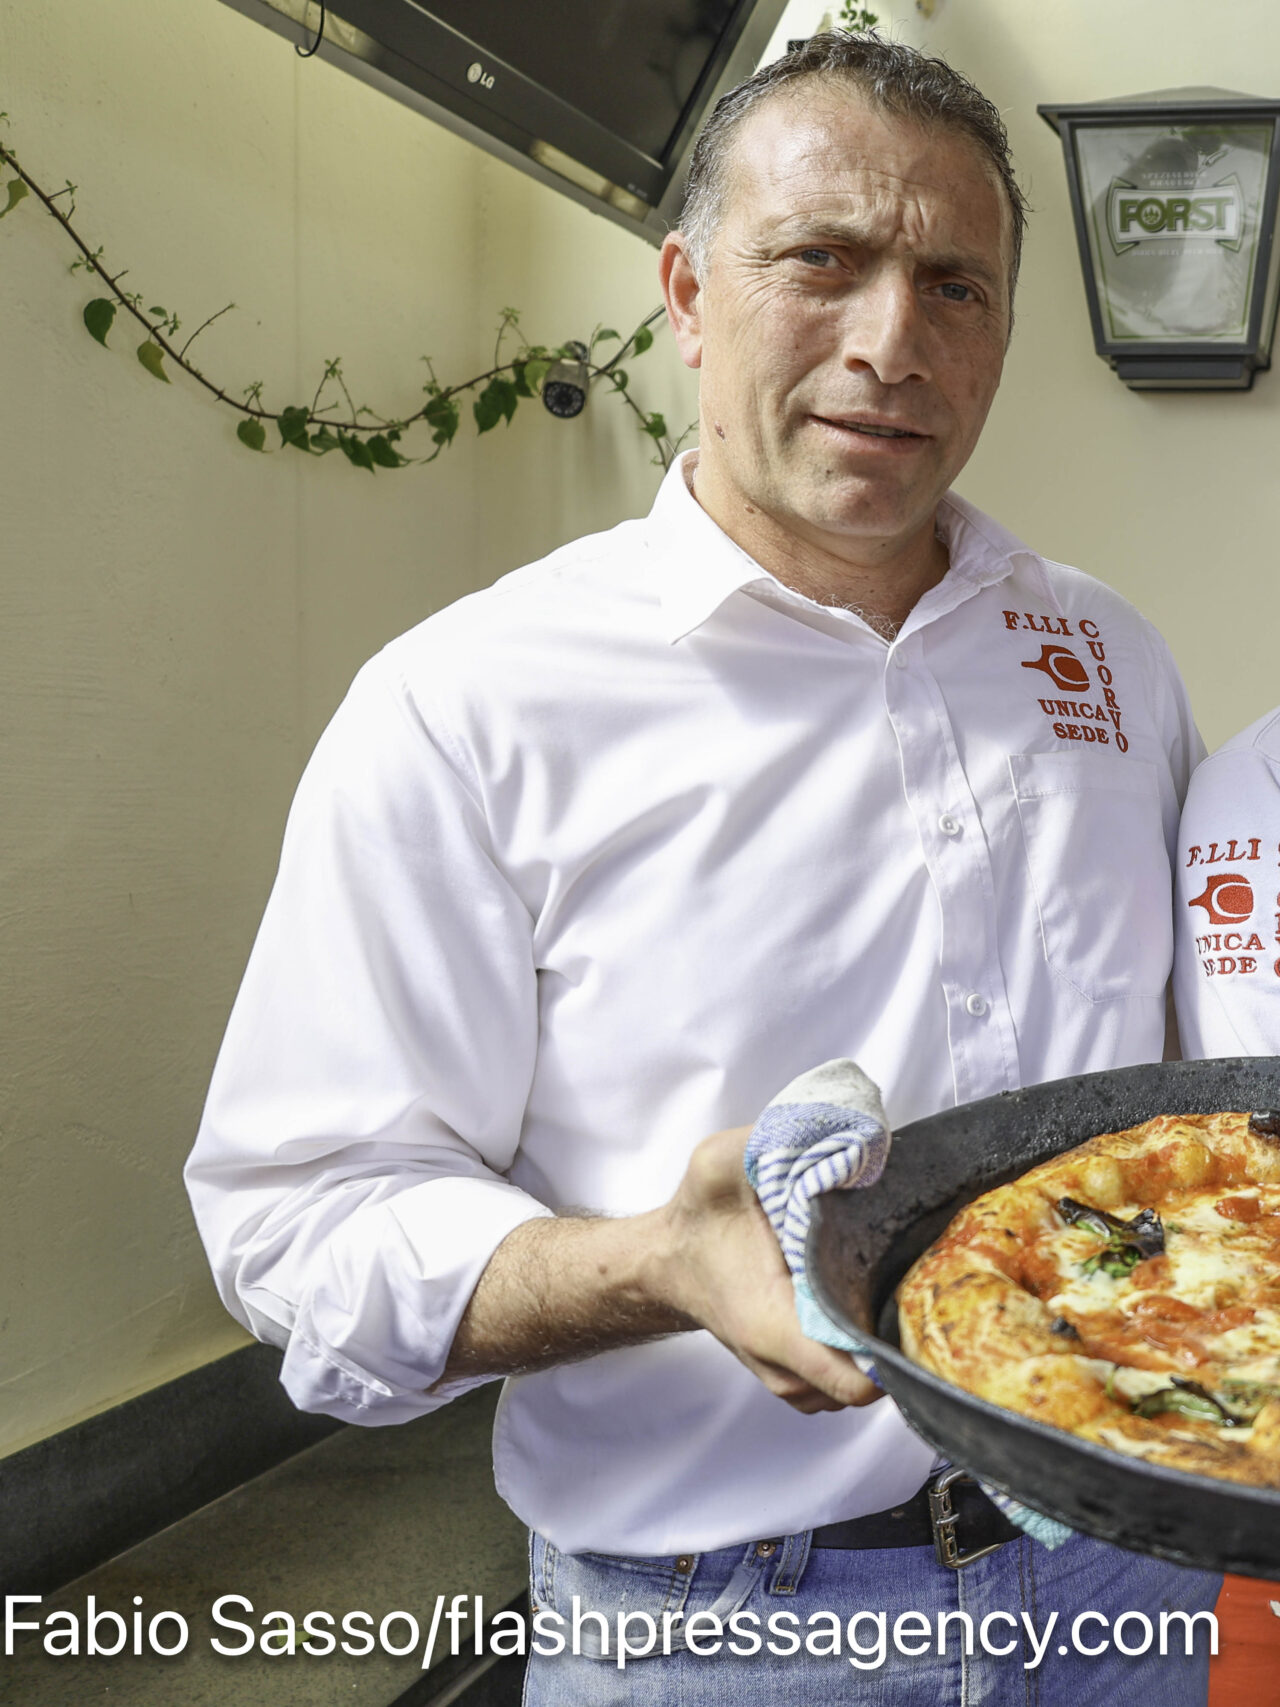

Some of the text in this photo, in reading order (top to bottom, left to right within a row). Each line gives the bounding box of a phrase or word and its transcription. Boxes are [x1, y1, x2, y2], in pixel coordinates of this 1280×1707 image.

[480, 72, 495, 89] LG
[1119, 197, 1234, 233] FORST
[1002, 610, 1074, 637] F.LLI
[1078, 619, 1129, 753] CUORVO
[1037, 698, 1109, 722] UNICA
[1052, 722, 1110, 744] SEDE
[1186, 838, 1262, 868] F.LLI
